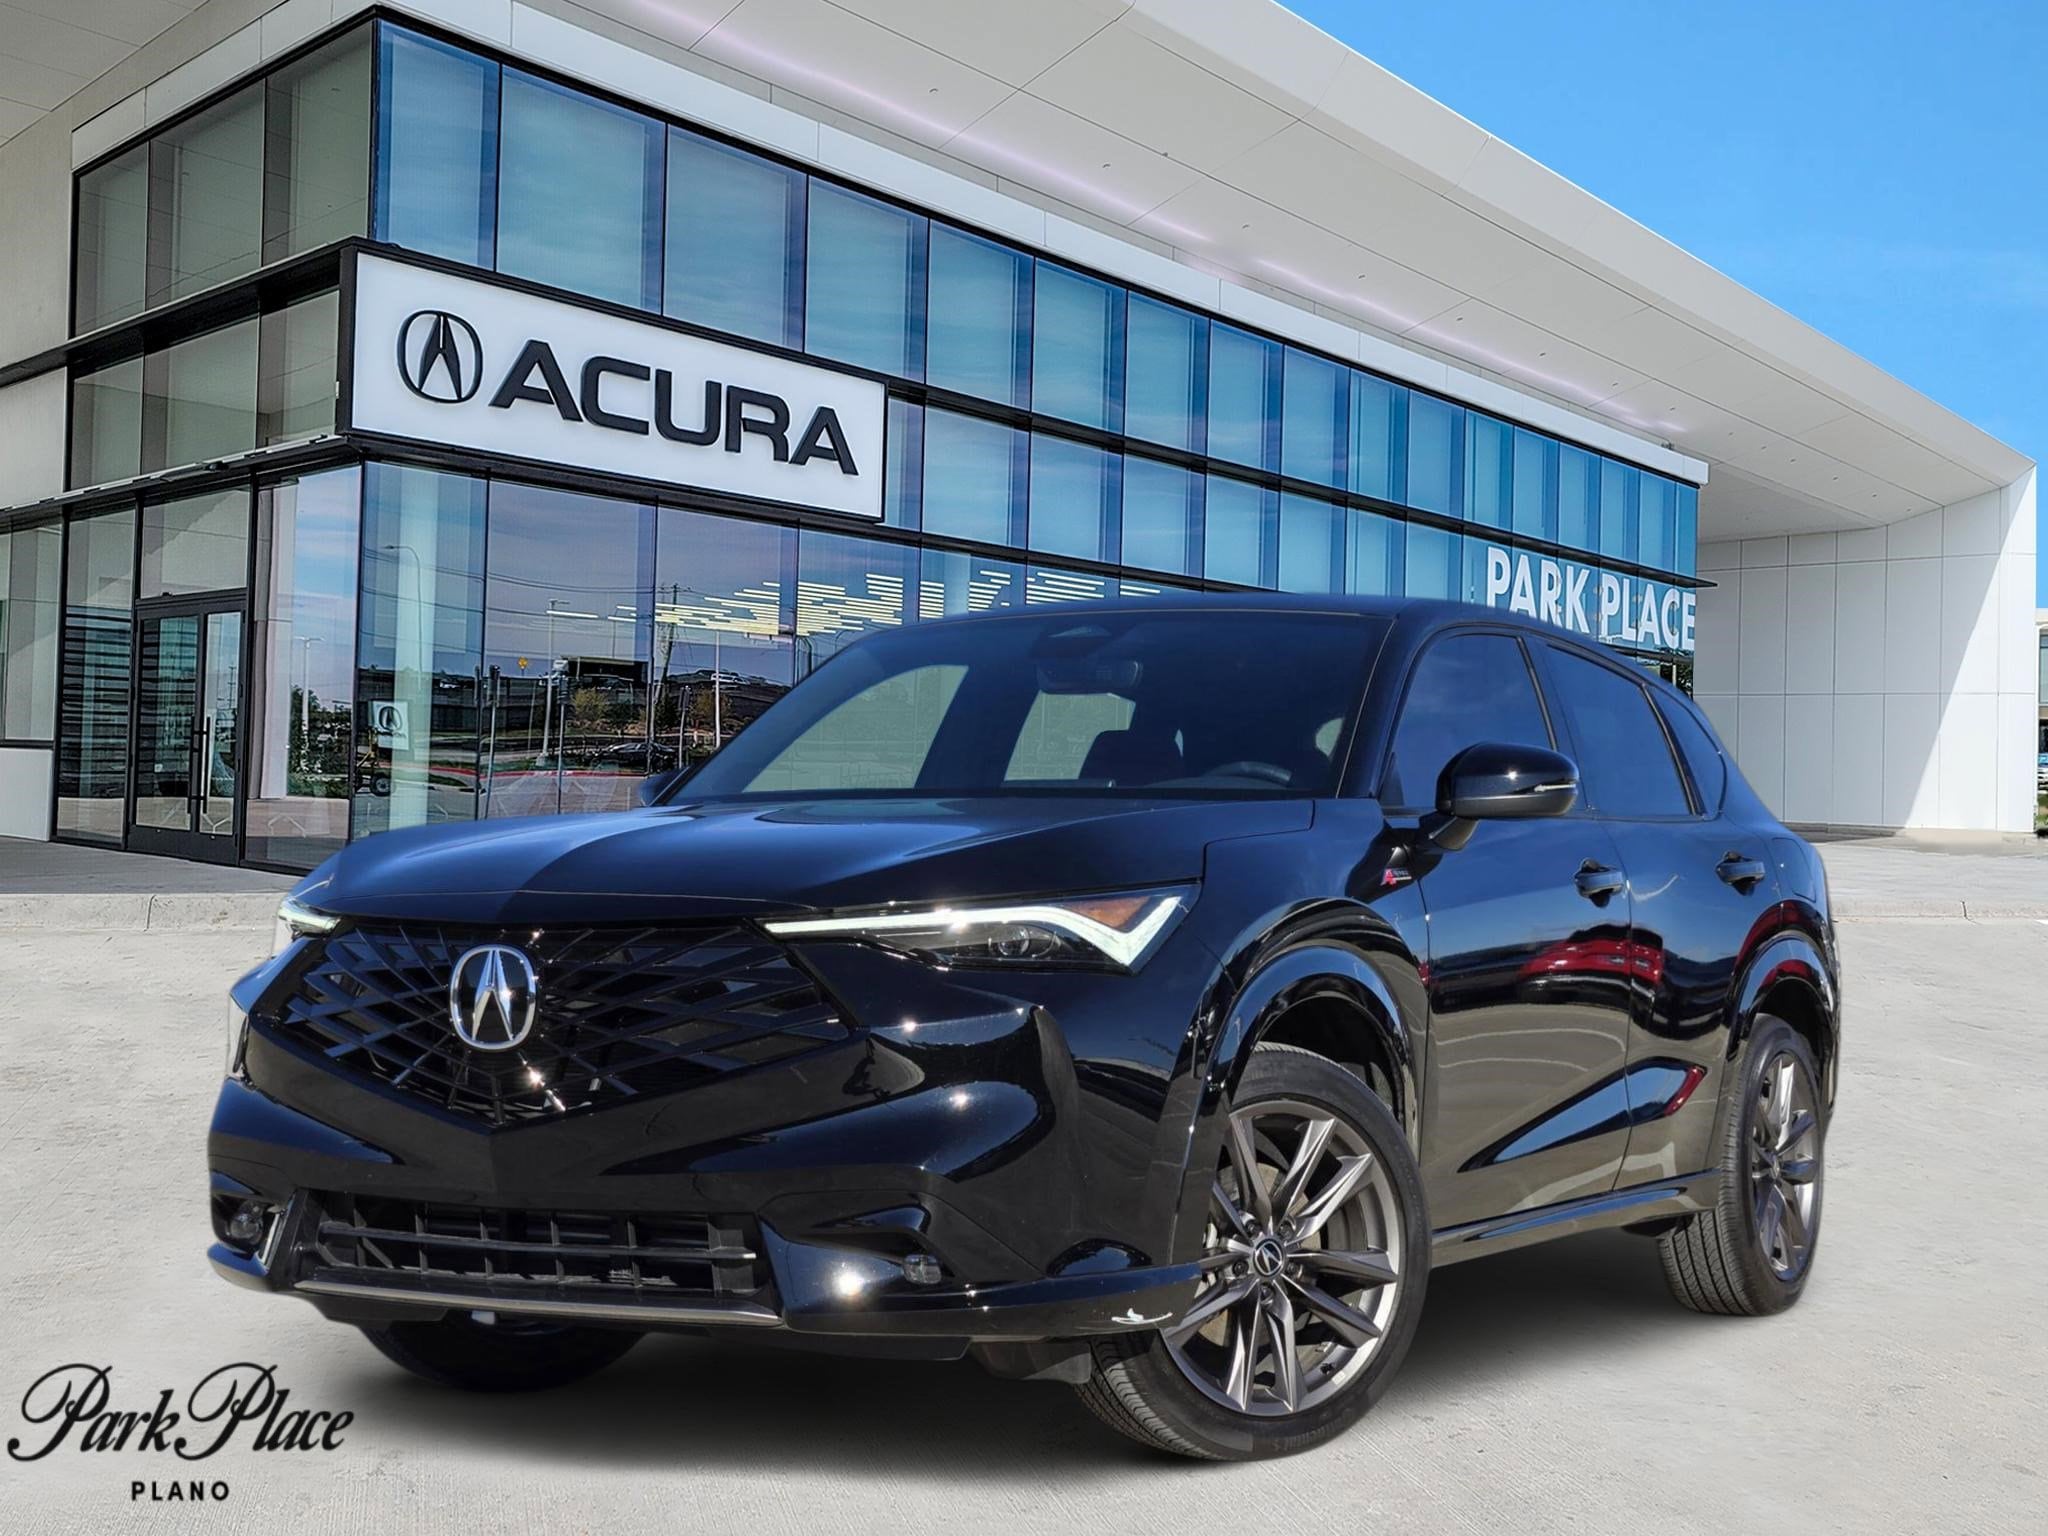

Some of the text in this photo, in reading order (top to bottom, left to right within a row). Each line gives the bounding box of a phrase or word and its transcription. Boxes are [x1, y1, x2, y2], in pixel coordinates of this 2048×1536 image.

[488, 339, 859, 477] ACURA
[1487, 546, 1696, 650] PARK PLACE
